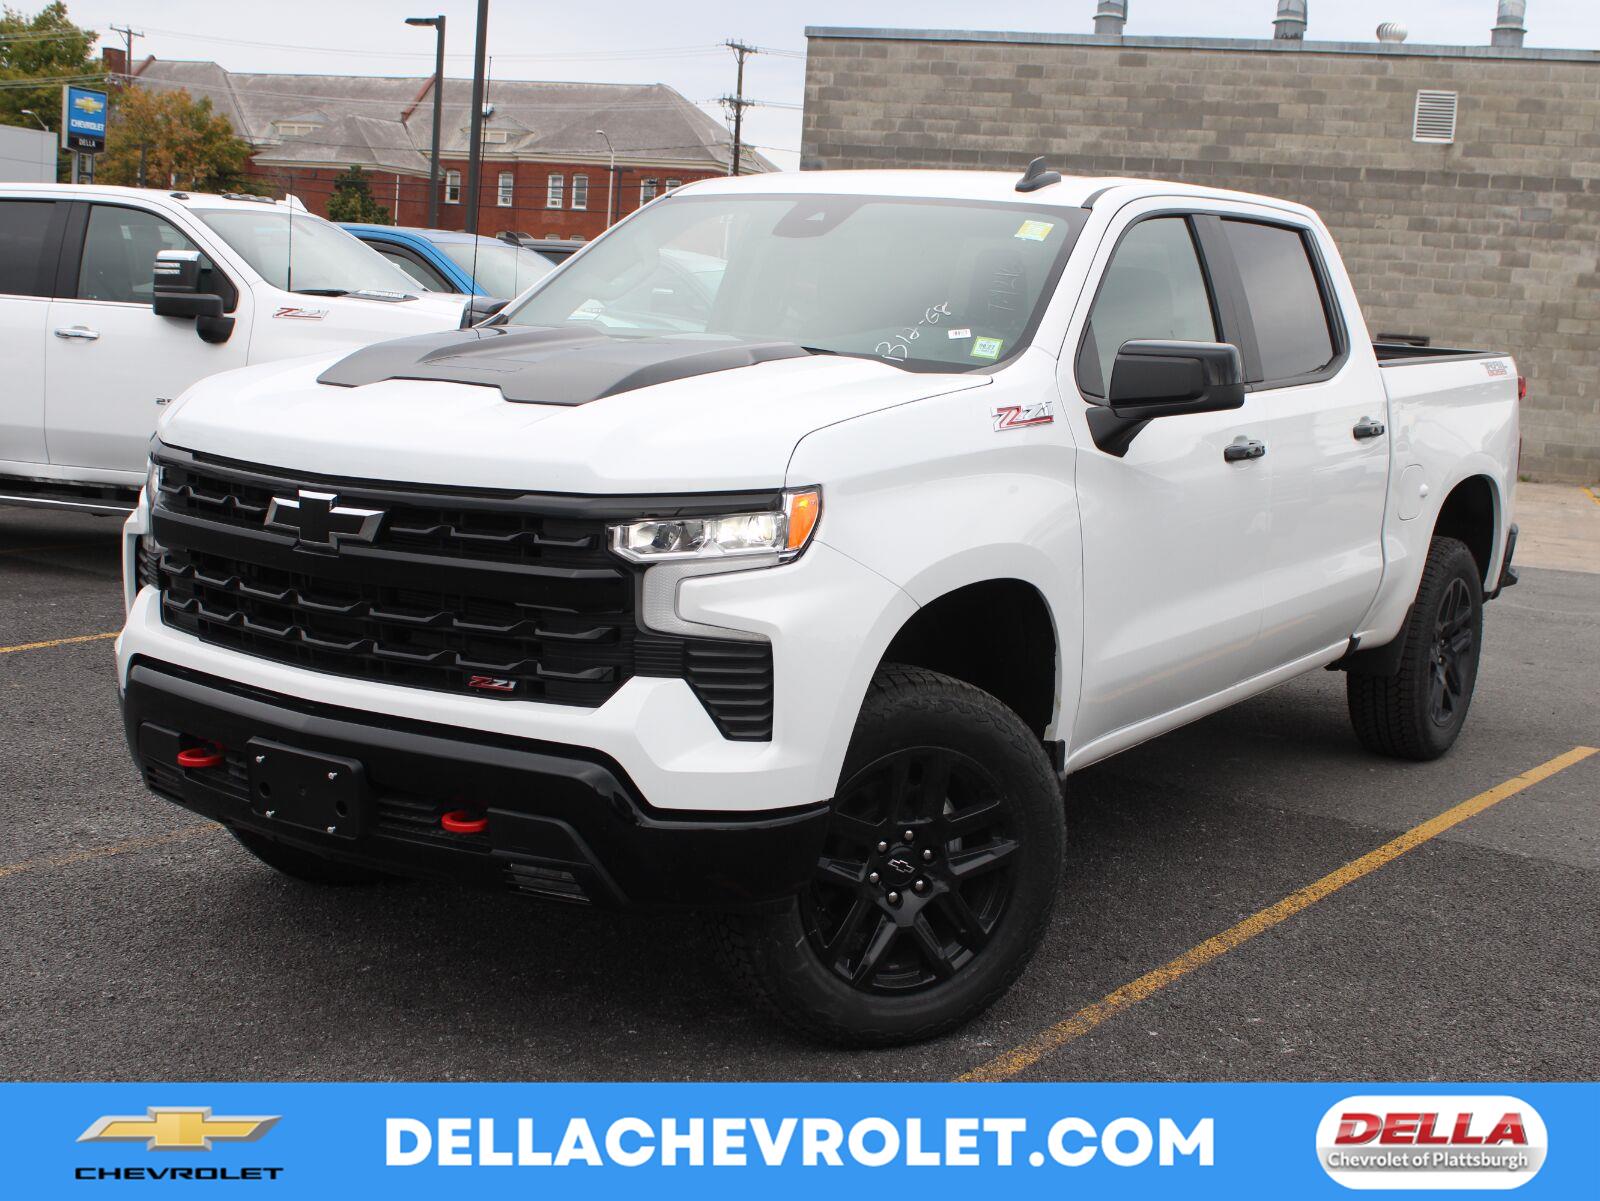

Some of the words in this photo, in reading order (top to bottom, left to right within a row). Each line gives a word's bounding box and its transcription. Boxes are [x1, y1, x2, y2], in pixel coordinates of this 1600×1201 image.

[71, 119, 105, 131] CHEVROLET
[79, 138, 96, 147] DELLA
[991, 401, 1054, 432] Z71
[469, 675, 516, 691] Z71
